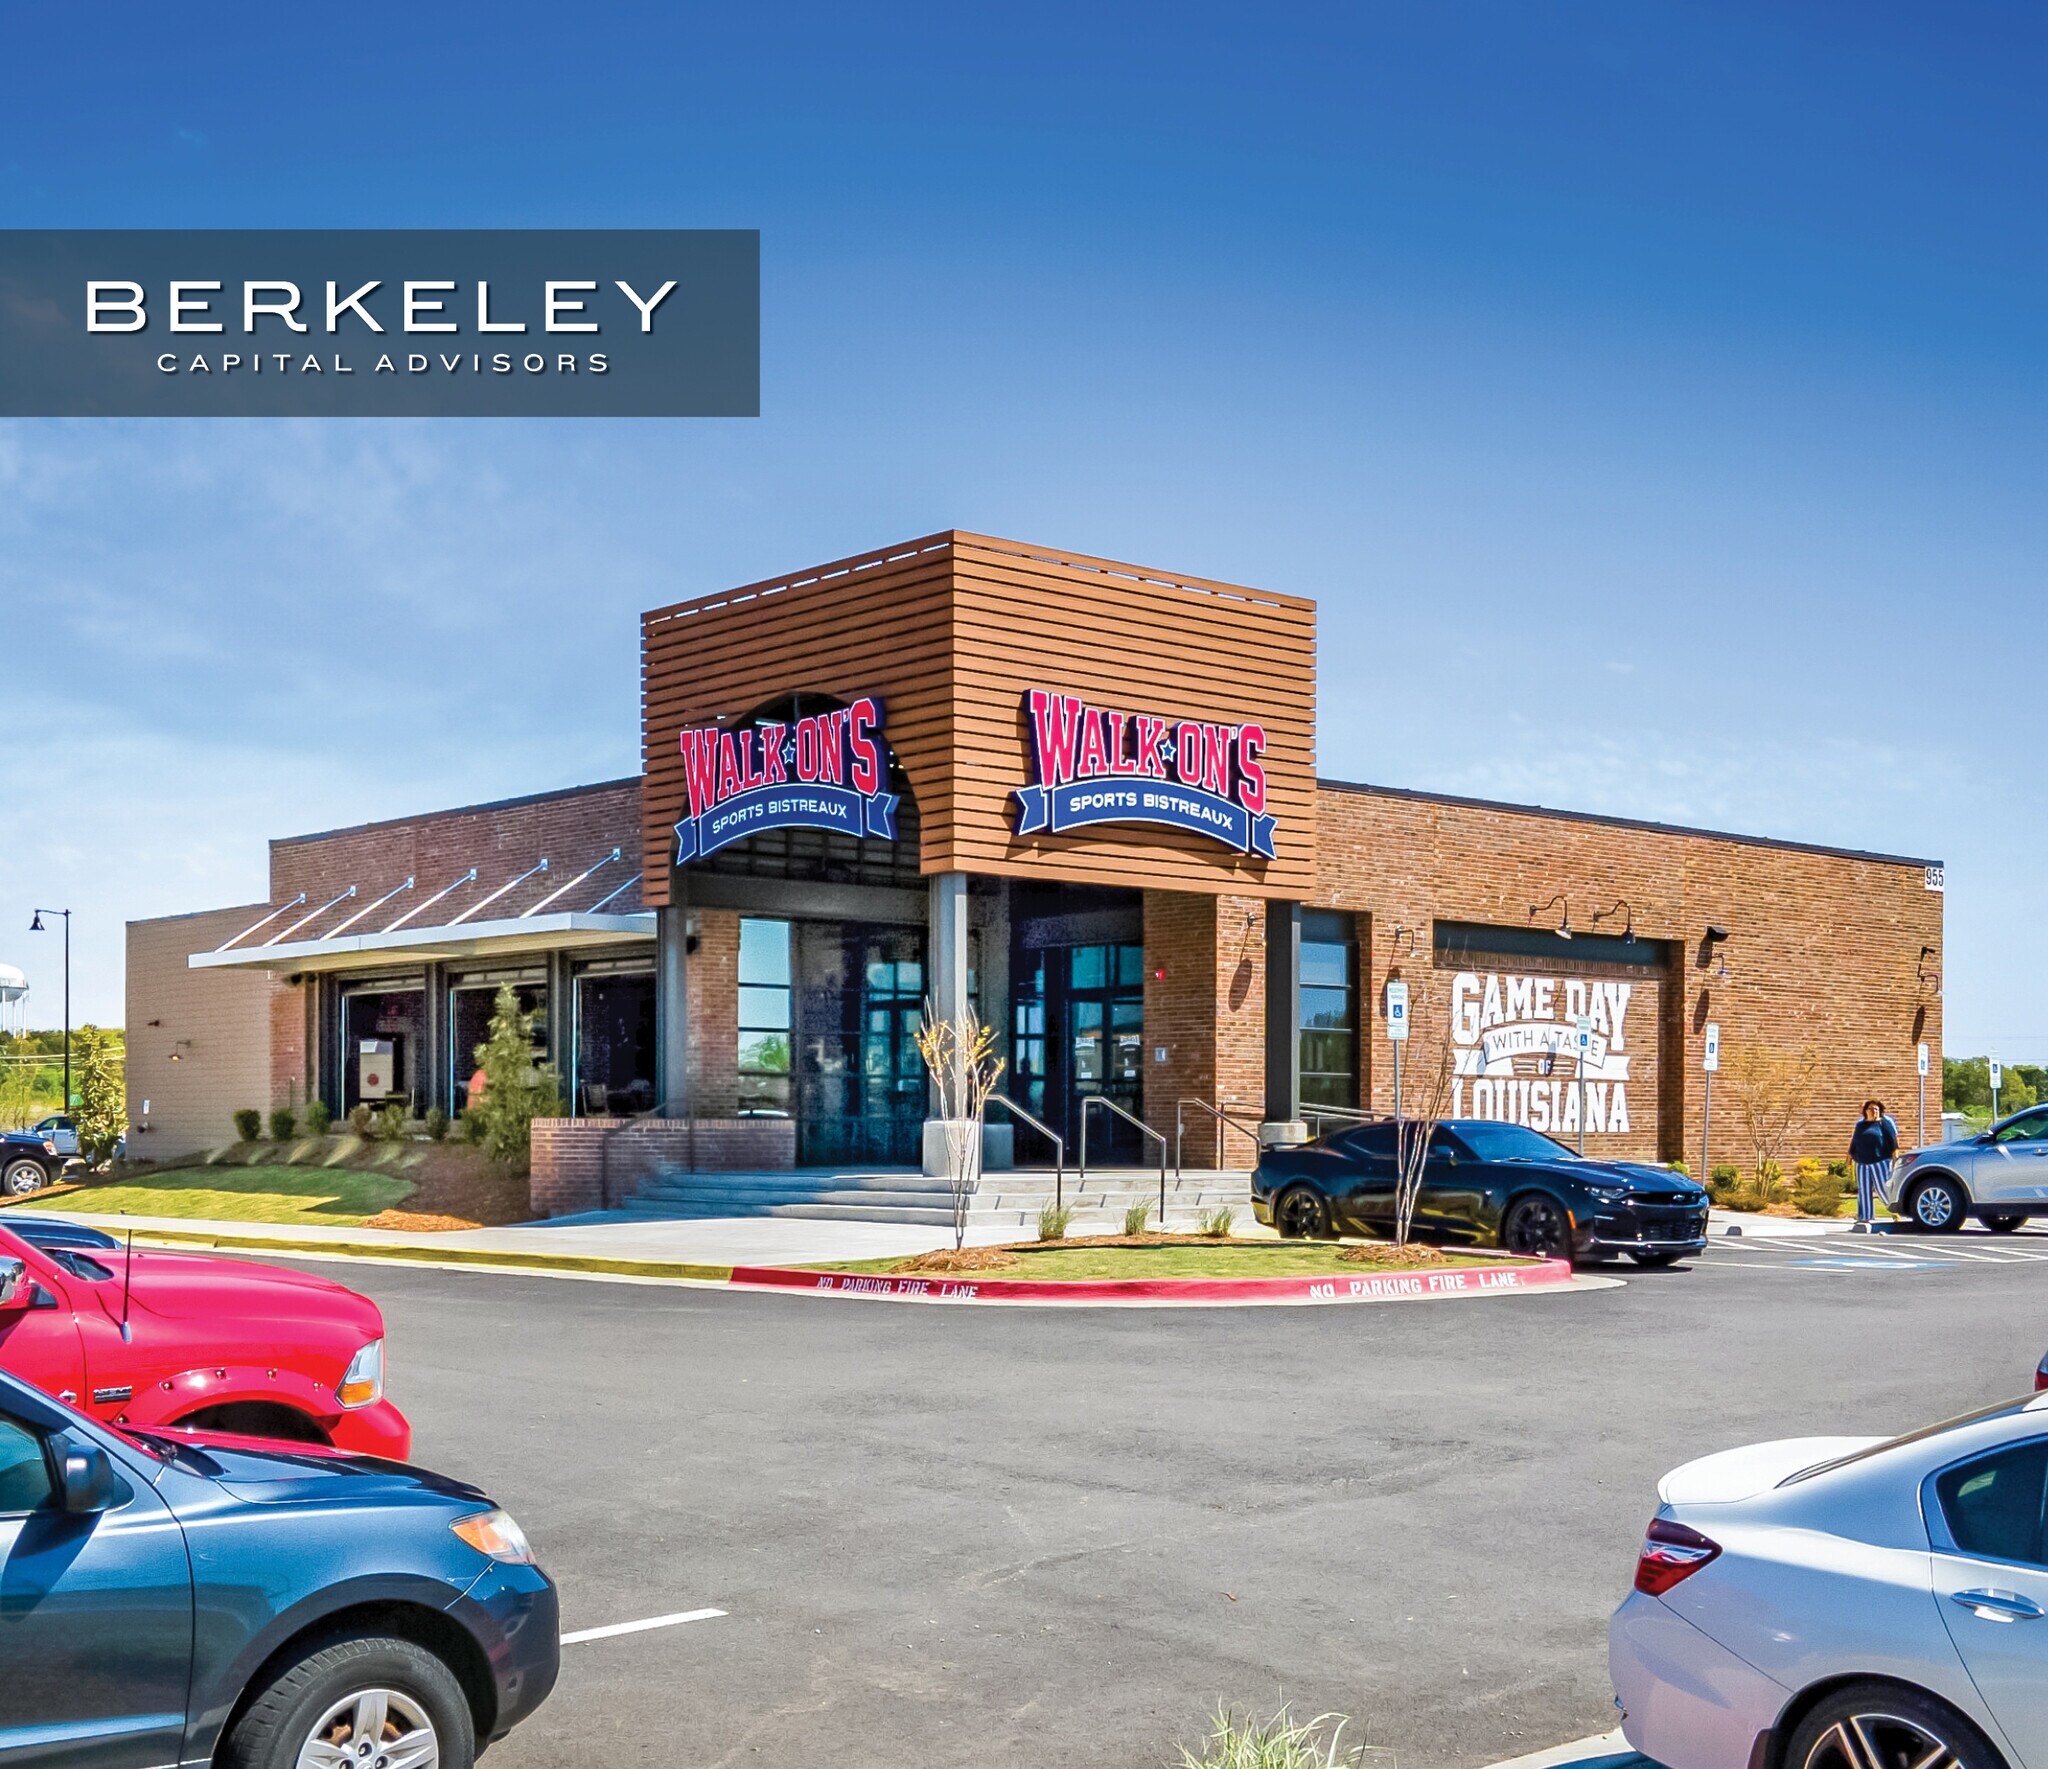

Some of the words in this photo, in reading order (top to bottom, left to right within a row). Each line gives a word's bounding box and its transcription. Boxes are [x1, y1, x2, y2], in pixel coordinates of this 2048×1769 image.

[680, 723, 787, 820] WALK
[796, 697, 878, 796] ON'S
[1030, 688, 1166, 791] WALK
[1177, 721, 1266, 816] ON'S
[712, 803, 764, 834] SPORTS
[768, 799, 848, 819] BISTREAUX
[1069, 792, 1138, 813] SPORTS
[1142, 793, 1233, 831] BISTREAUX
[1926, 868, 1944, 887] 955
[1451, 972, 1555, 1045] GAME
[1564, 979, 1632, 1051] DAY
[1492, 1030, 1534, 1051] WITH
[1539, 1031, 1550, 1048] A
[1537, 1058, 1552, 1076] OF
[1451, 1078, 1630, 1132] LOUISIANA
[816, 1276, 834, 1290] NO
[840, 1277, 892, 1294] PARKING
[896, 1279, 931, 1296] FIRE
[939, 1283, 979, 1299] LANE
[1309, 1282, 1336, 1299] NO
[1349, 1278, 1422, 1297] PARKING
[1428, 1274, 1467, 1292] FIRE
[1478, 1272, 1518, 1288] LANE
